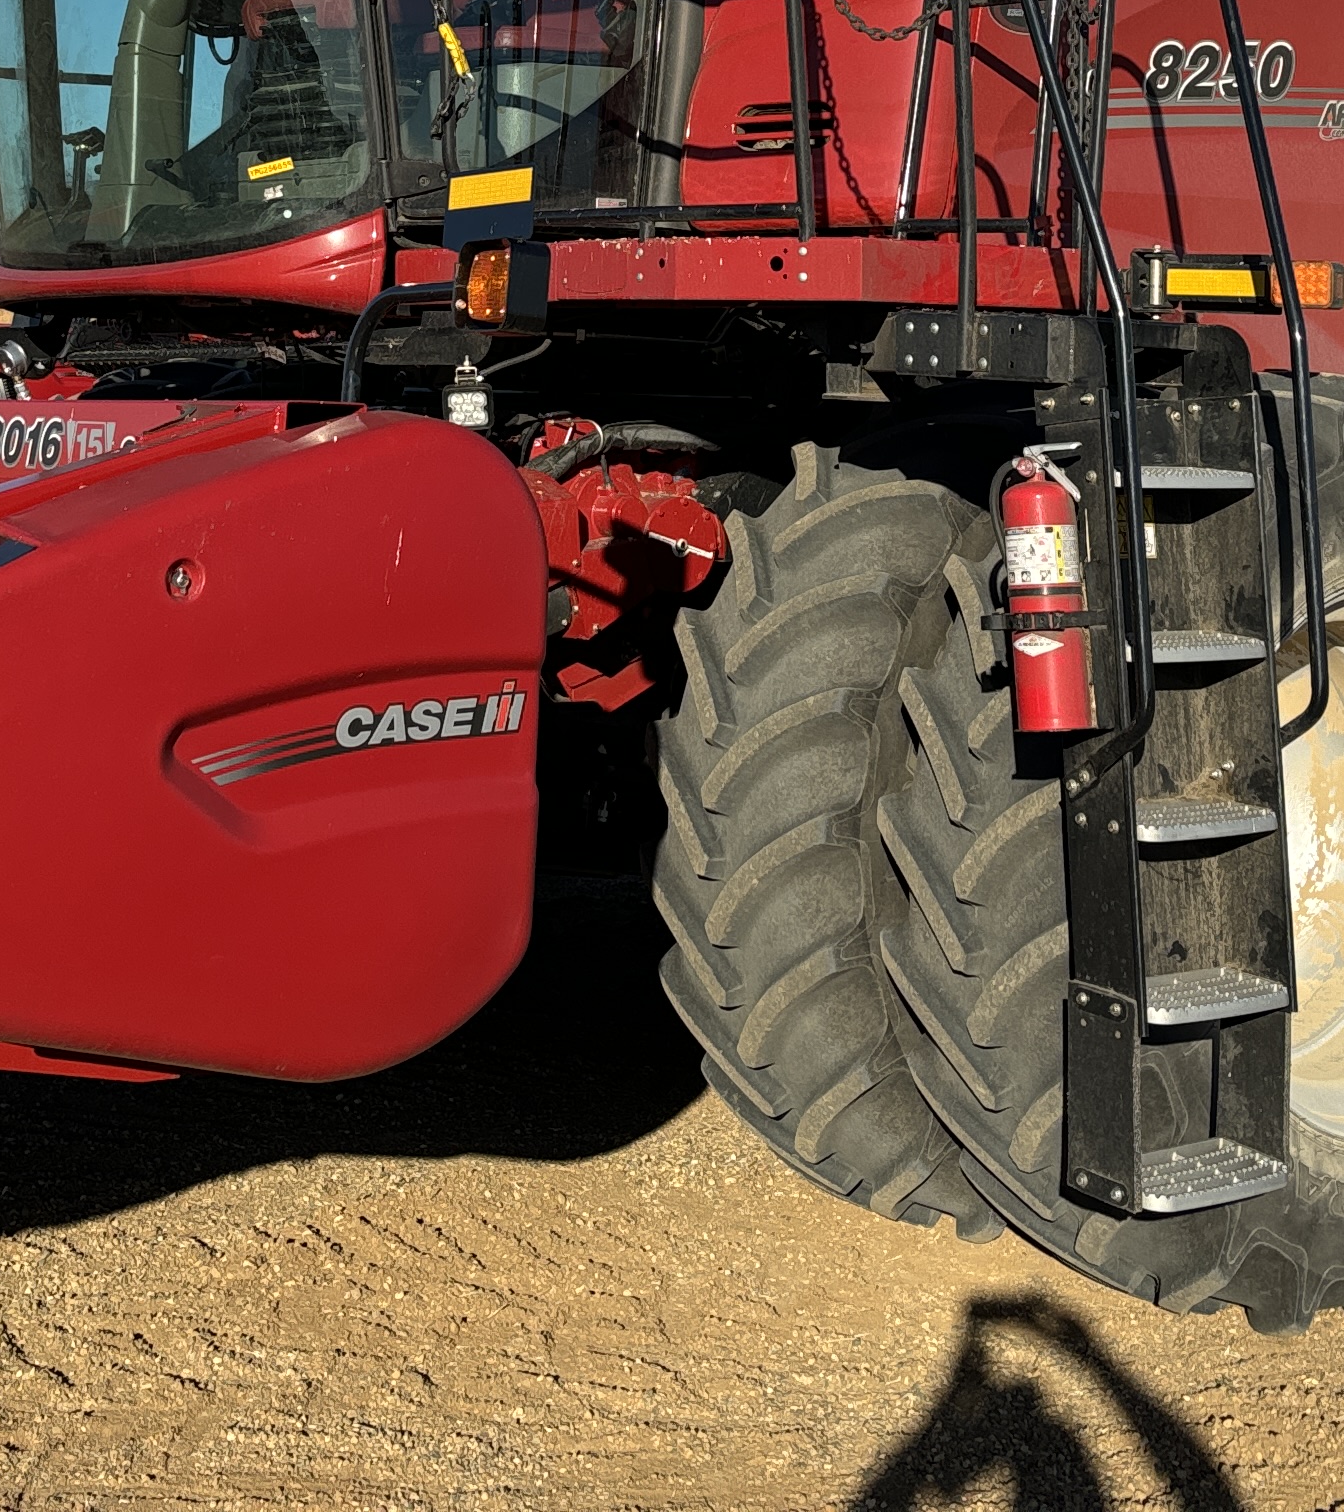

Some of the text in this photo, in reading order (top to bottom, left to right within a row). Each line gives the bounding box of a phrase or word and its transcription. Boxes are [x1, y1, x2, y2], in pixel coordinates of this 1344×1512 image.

[76, 427, 103, 460] 15
[335, 680, 526, 748] CASE IH
